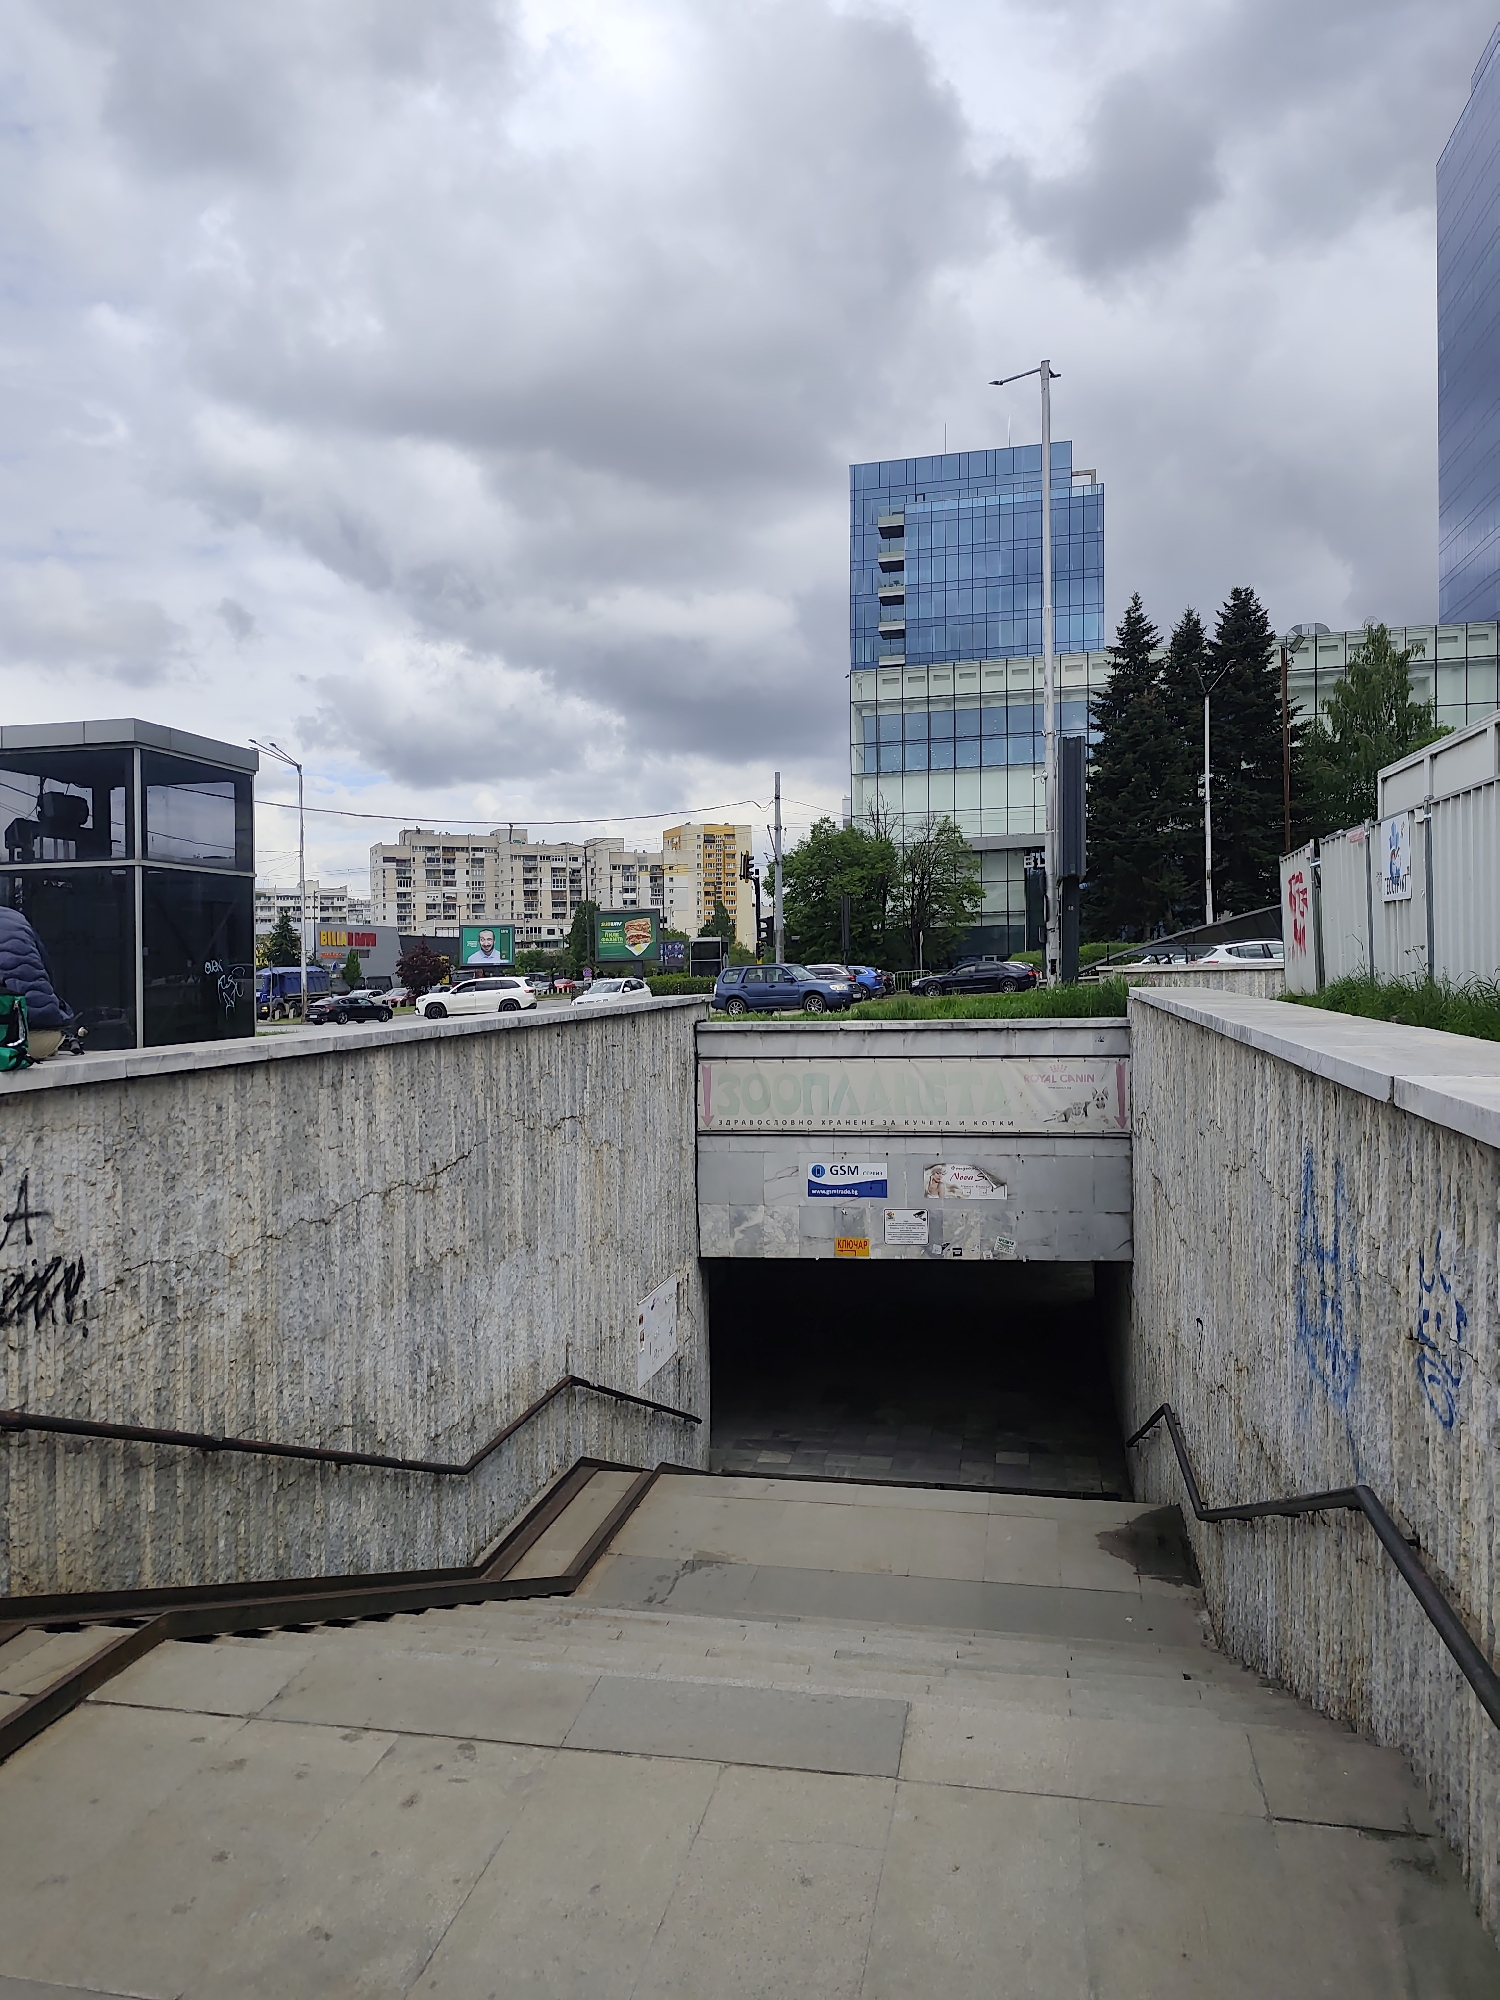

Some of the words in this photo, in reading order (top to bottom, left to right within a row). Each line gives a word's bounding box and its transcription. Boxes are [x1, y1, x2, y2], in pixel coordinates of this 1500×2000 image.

[320, 931, 346, 946] BILLA
[1023, 1074, 1057, 1083] ROYAL
[1060, 1074, 1095, 1083] CANIN
[717, 1070, 1012, 1116] ЗООПЛАНЕТА
[829, 1165, 859, 1176] GSM
[837, 1239, 868, 1250] КЛЮЧАР
